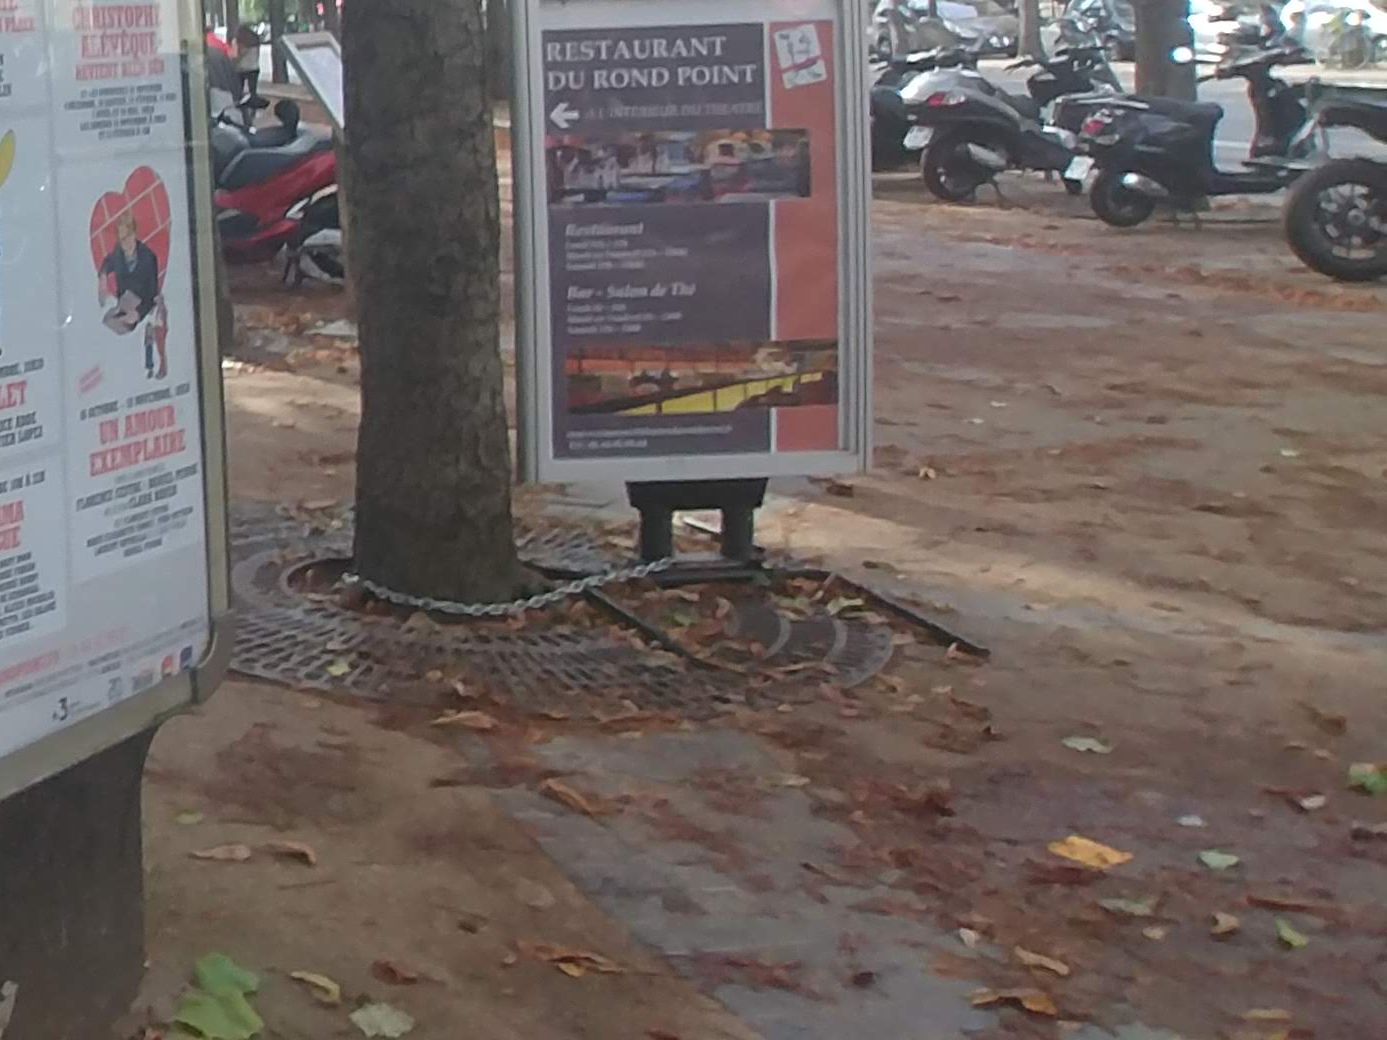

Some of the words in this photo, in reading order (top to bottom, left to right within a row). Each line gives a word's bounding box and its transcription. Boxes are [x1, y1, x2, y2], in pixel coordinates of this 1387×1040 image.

[547, 35, 727, 62] RESTAURANT
[547, 69, 585, 92] DU
[592, 67, 670, 90] ROND
[677, 63, 758, 86] POINT
[649, 282, 668, 297] de
[99, 418, 119, 445] UN
[124, 404, 176, 439] AMOUR
[89, 428, 187, 478] EXEMPLAIRE
